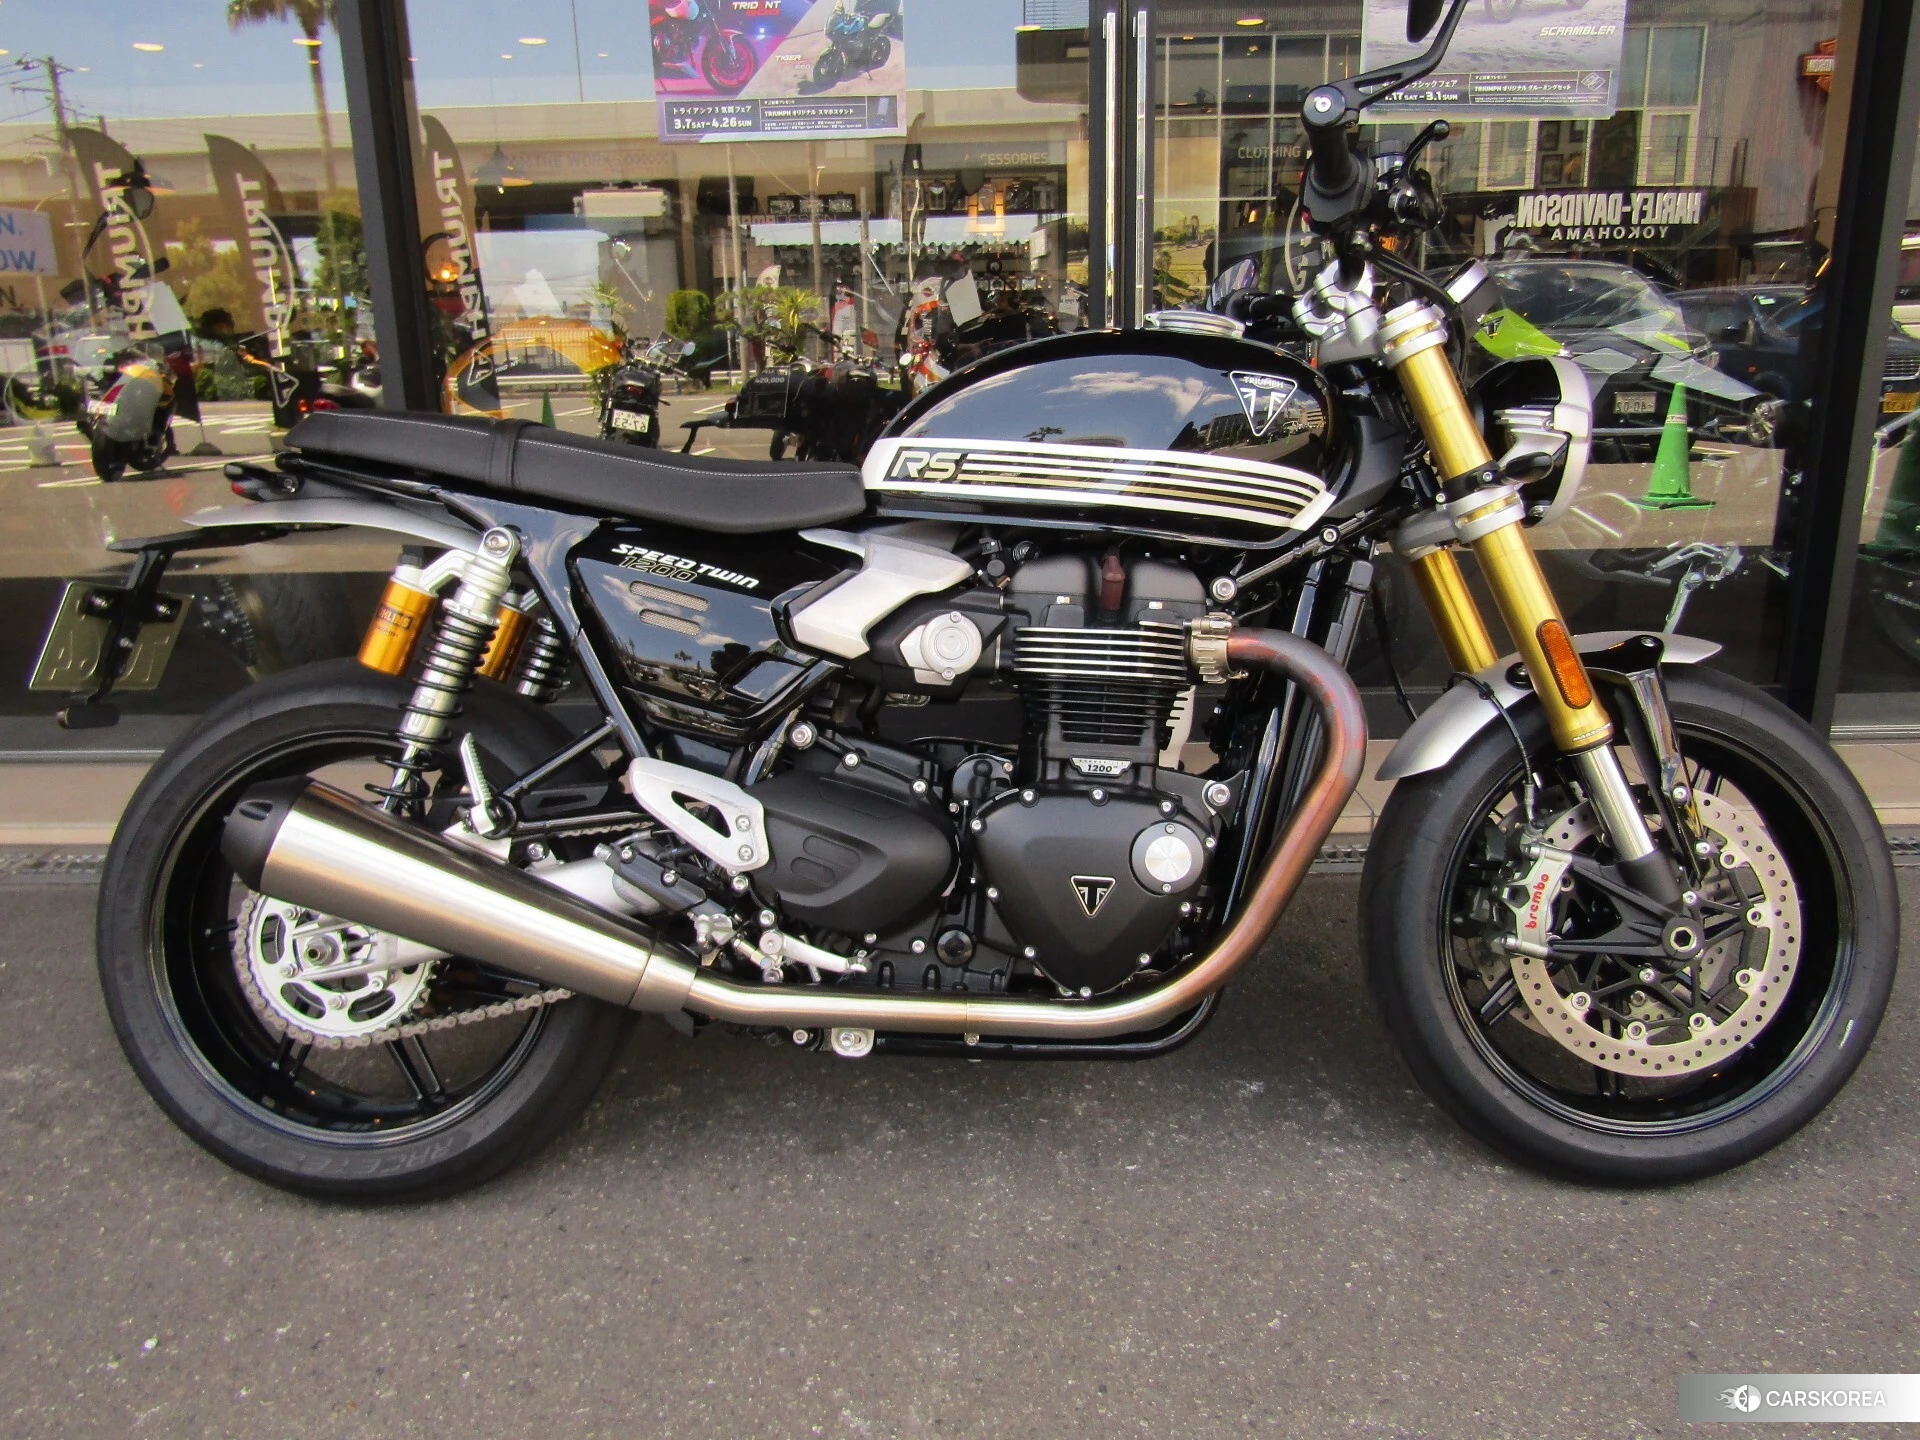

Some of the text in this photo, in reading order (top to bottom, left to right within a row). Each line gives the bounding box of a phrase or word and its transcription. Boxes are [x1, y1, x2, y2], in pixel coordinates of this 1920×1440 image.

[1540, 25, 1616, 36] SCRAMBLER
[964, 152, 1048, 165] ACESSORIES
[1238, 146, 1300, 159] CLOTHING
[1243, 376, 1284, 388] TRIUMPH
[890, 450, 962, 479] RS
[611, 543, 760, 589] SPEED TWIN
[618, 556, 698, 583] 1200
[1088, 764, 1113, 773] 1200
[1524, 873, 1549, 929] brembo
